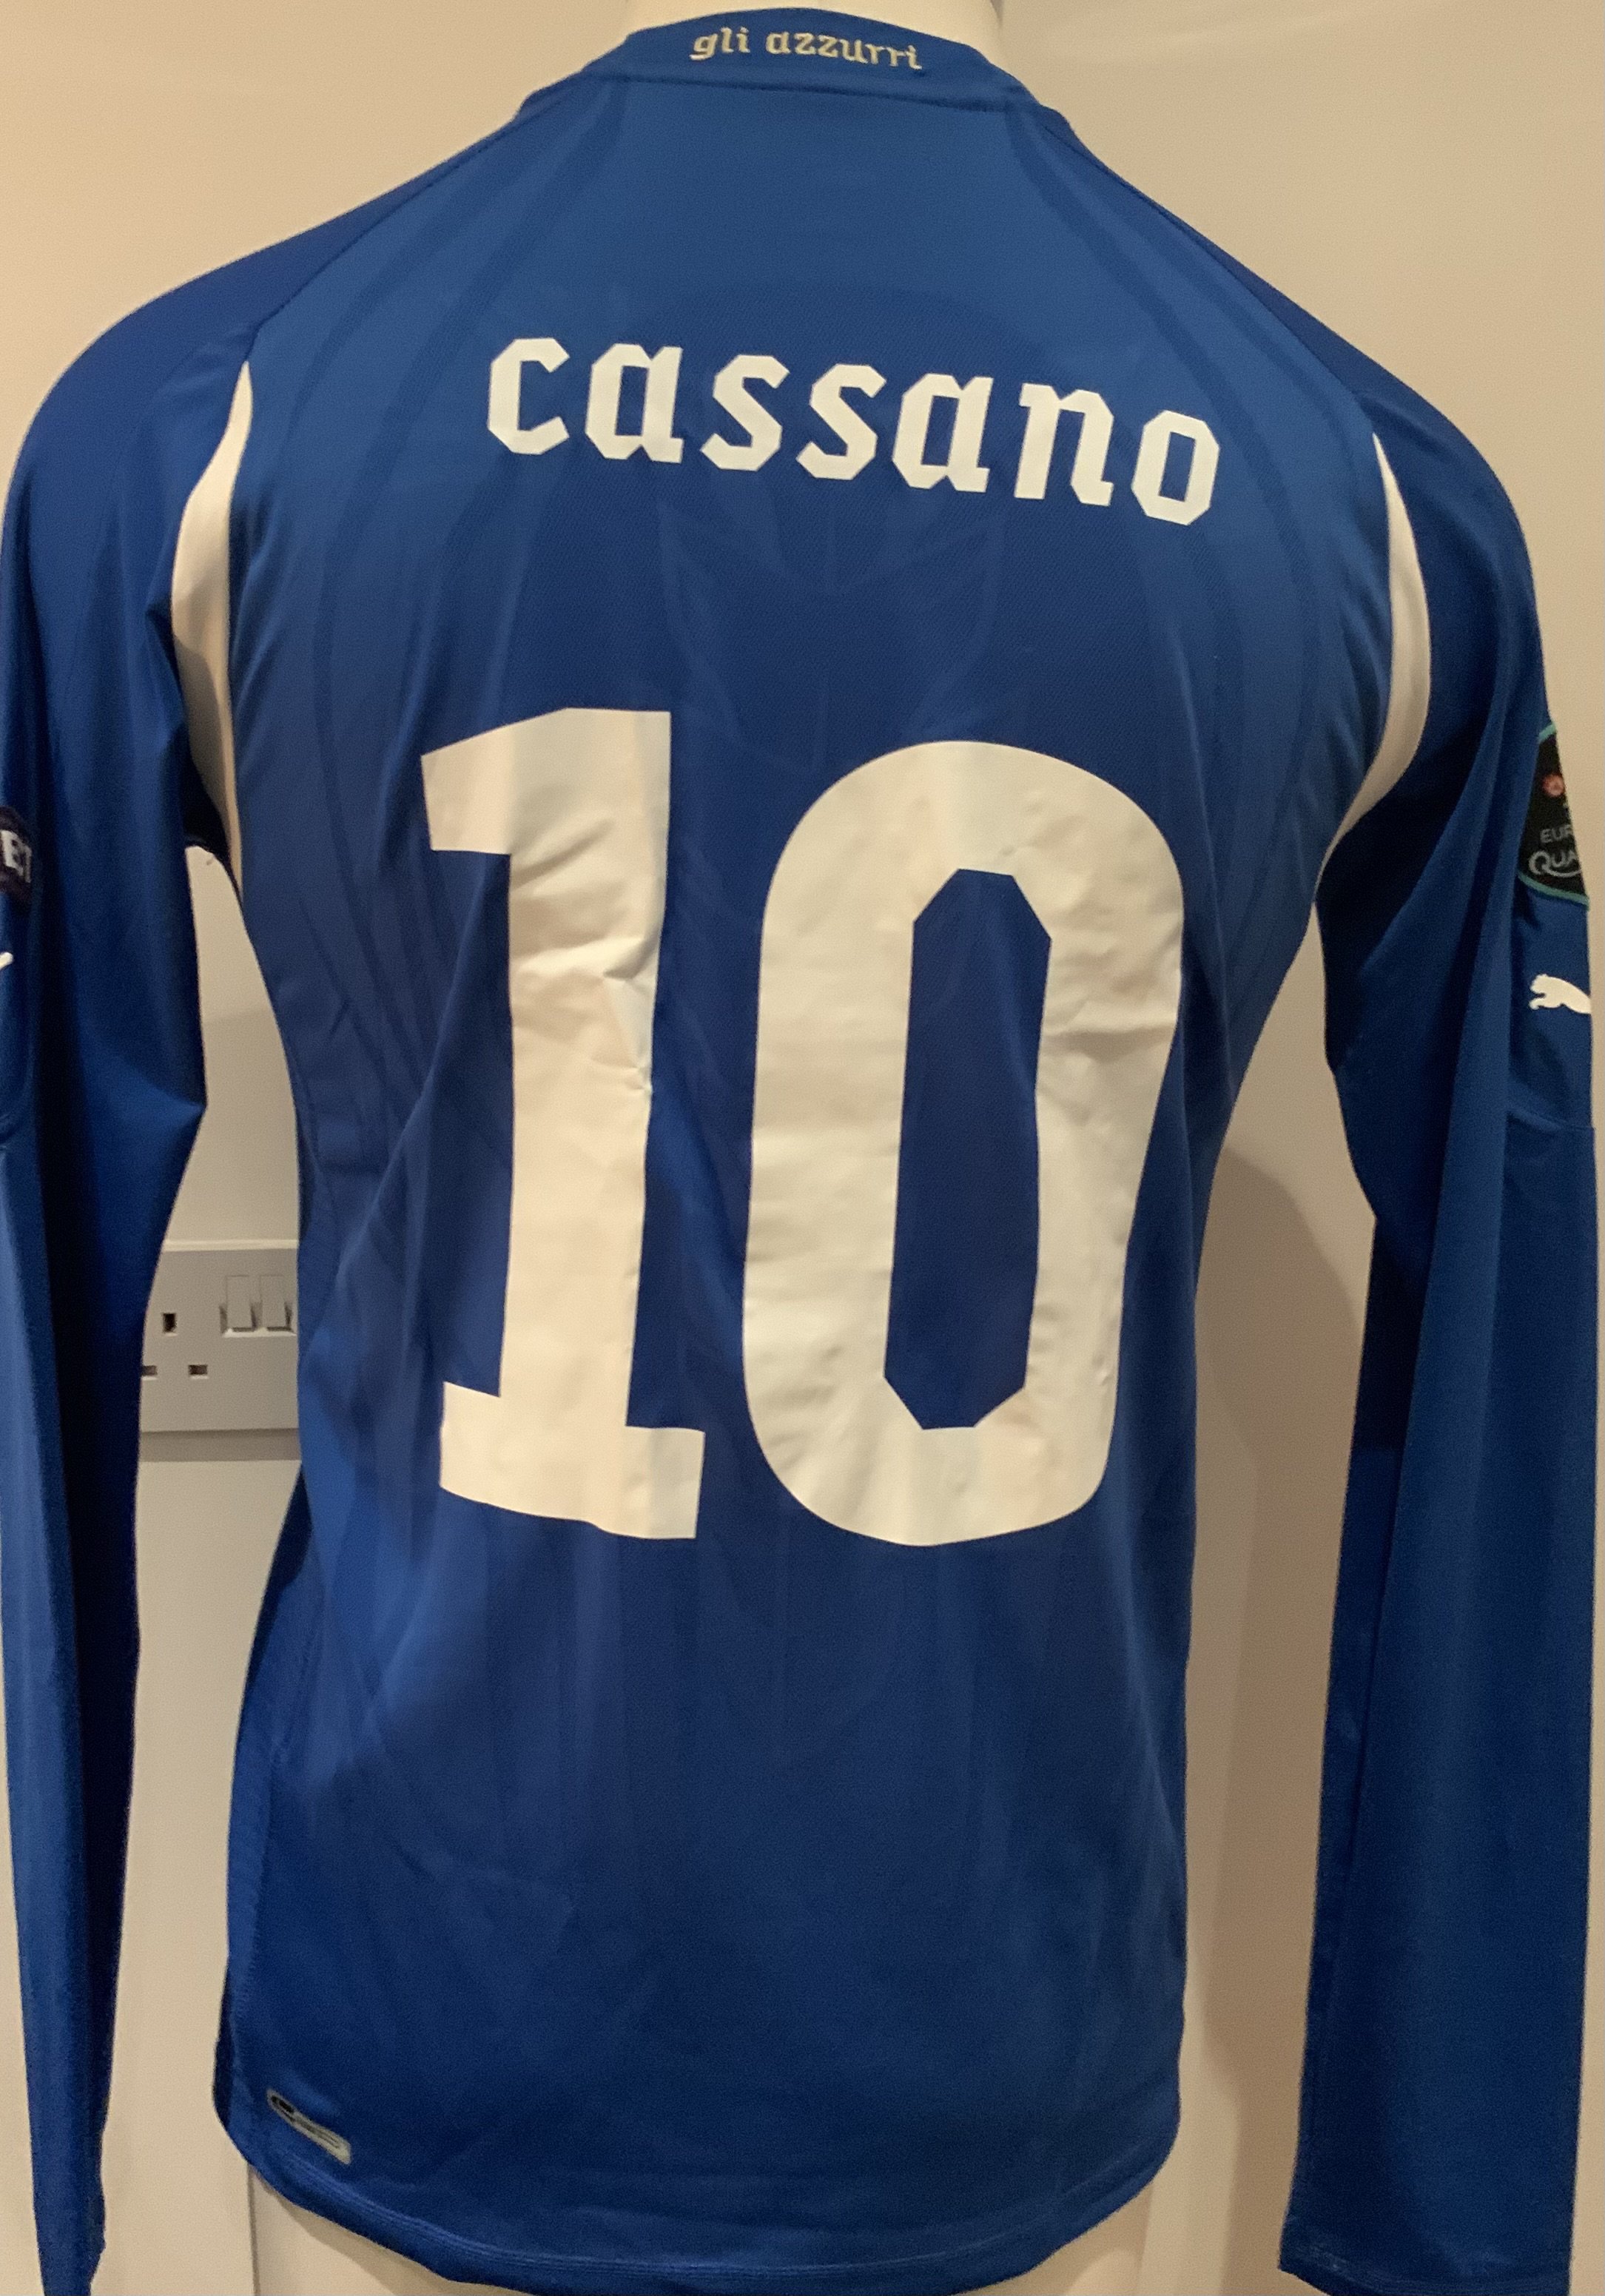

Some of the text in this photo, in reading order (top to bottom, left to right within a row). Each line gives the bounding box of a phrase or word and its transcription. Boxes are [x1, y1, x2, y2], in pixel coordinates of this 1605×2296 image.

[689, 27, 923, 70] gli azzurri
[486, 337, 1221, 526] cassano
[420, 707, 1185, 1547] 10
